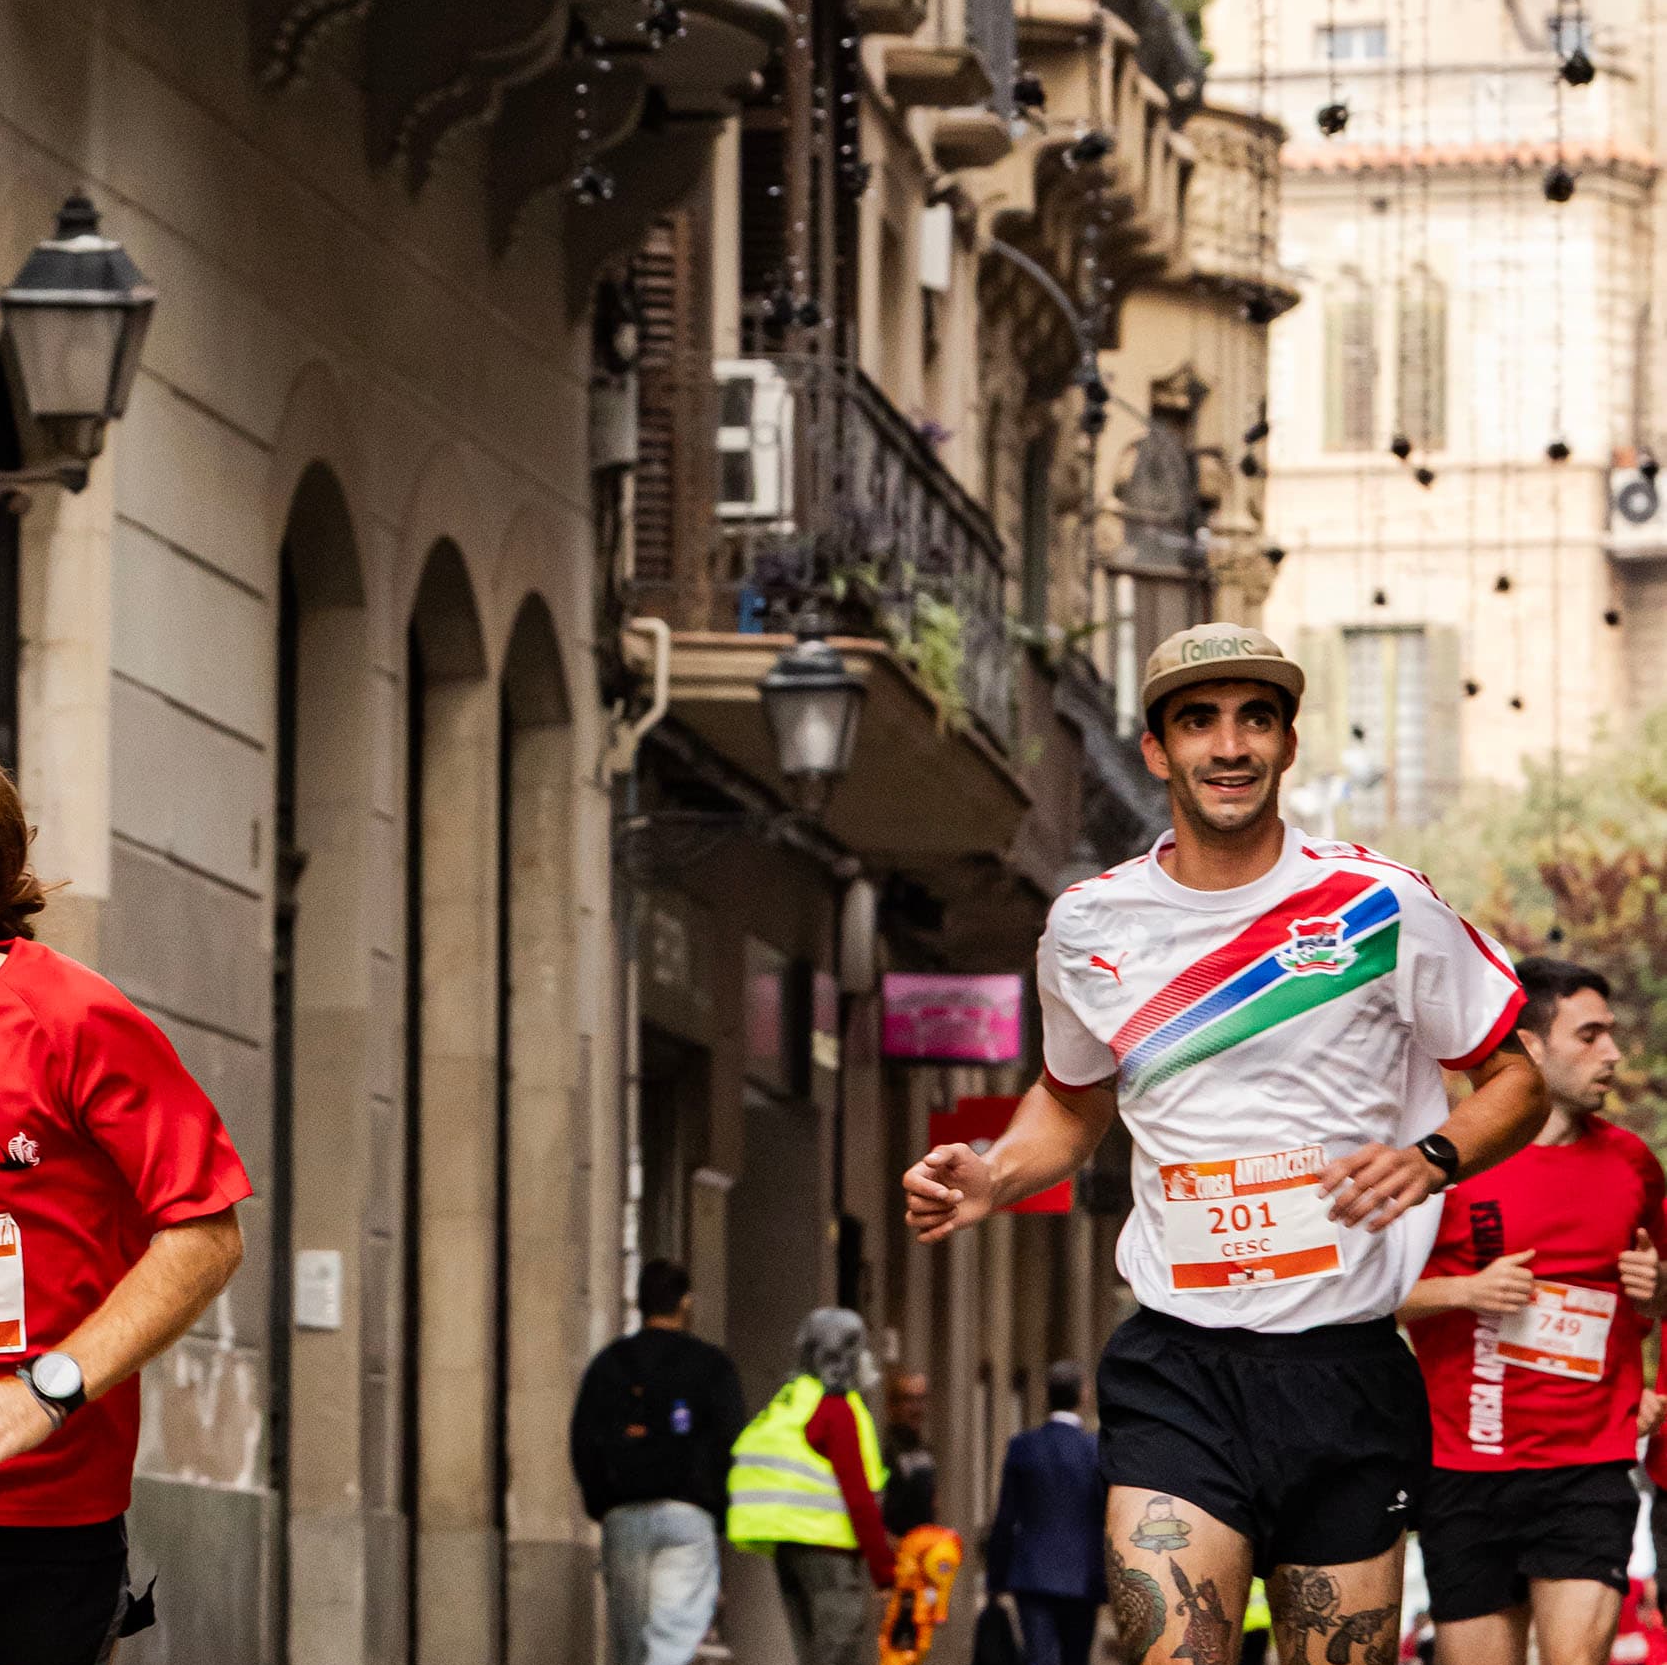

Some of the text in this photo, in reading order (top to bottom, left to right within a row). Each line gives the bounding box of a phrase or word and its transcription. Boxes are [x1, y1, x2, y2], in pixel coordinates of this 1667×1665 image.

[1207, 1202, 1278, 1235] 201
[1221, 1238, 1272, 1257] CESC
[1538, 1312, 1582, 1336] 749
